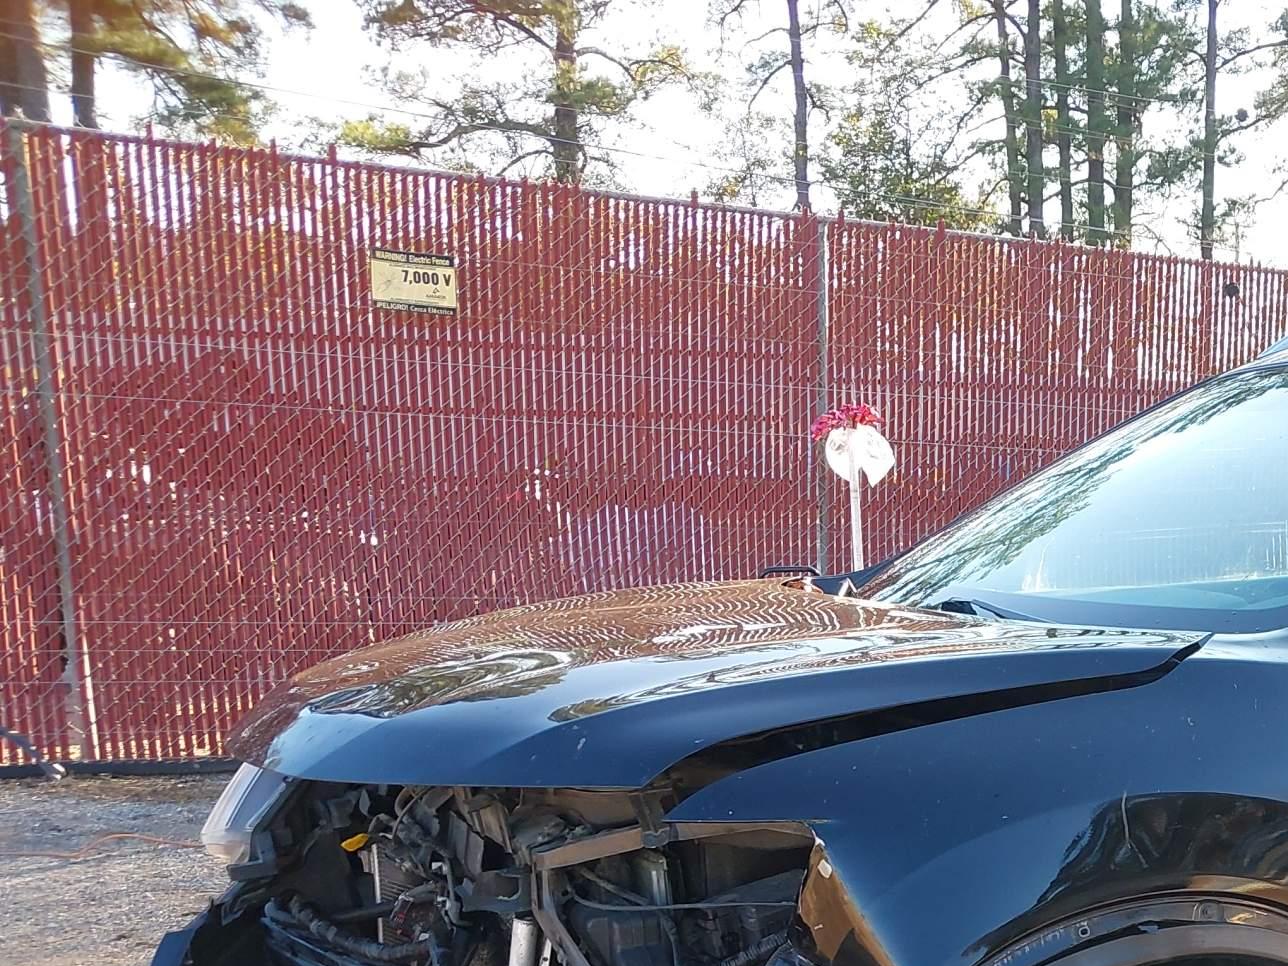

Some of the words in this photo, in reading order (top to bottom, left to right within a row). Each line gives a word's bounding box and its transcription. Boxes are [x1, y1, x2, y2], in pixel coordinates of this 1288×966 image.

[375, 251, 407, 261] WARNING!
[409, 255, 431, 263] Electric
[432, 257, 449, 265] Fence
[401, 270, 439, 285] 7,000
[443, 274, 451, 286] V
